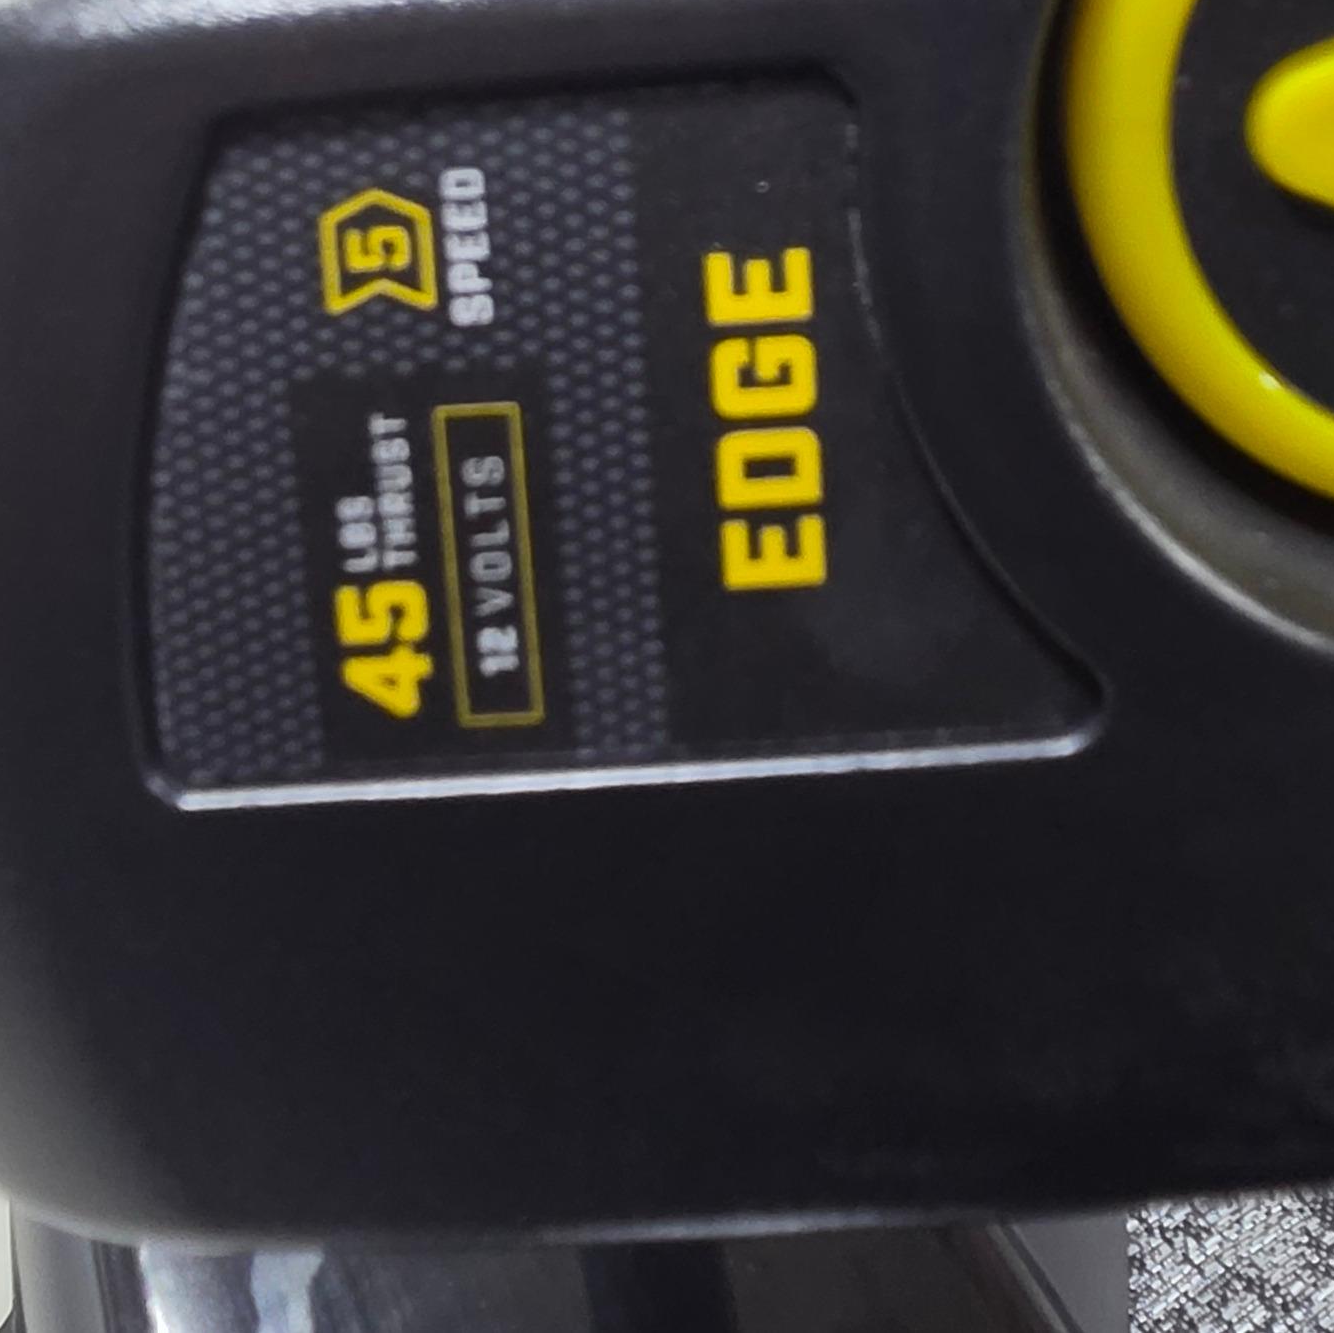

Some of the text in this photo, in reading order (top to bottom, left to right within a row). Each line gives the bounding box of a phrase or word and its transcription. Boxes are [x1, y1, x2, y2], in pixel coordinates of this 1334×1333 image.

[343, 224, 411, 273] 5
[438, 167, 495, 326] SPEED
[368, 412, 420, 570] THRUST
[703, 247, 829, 591] EDGE
[334, 495, 434, 718] 45 LBS
[461, 455, 520, 678] 12 VOLTS
